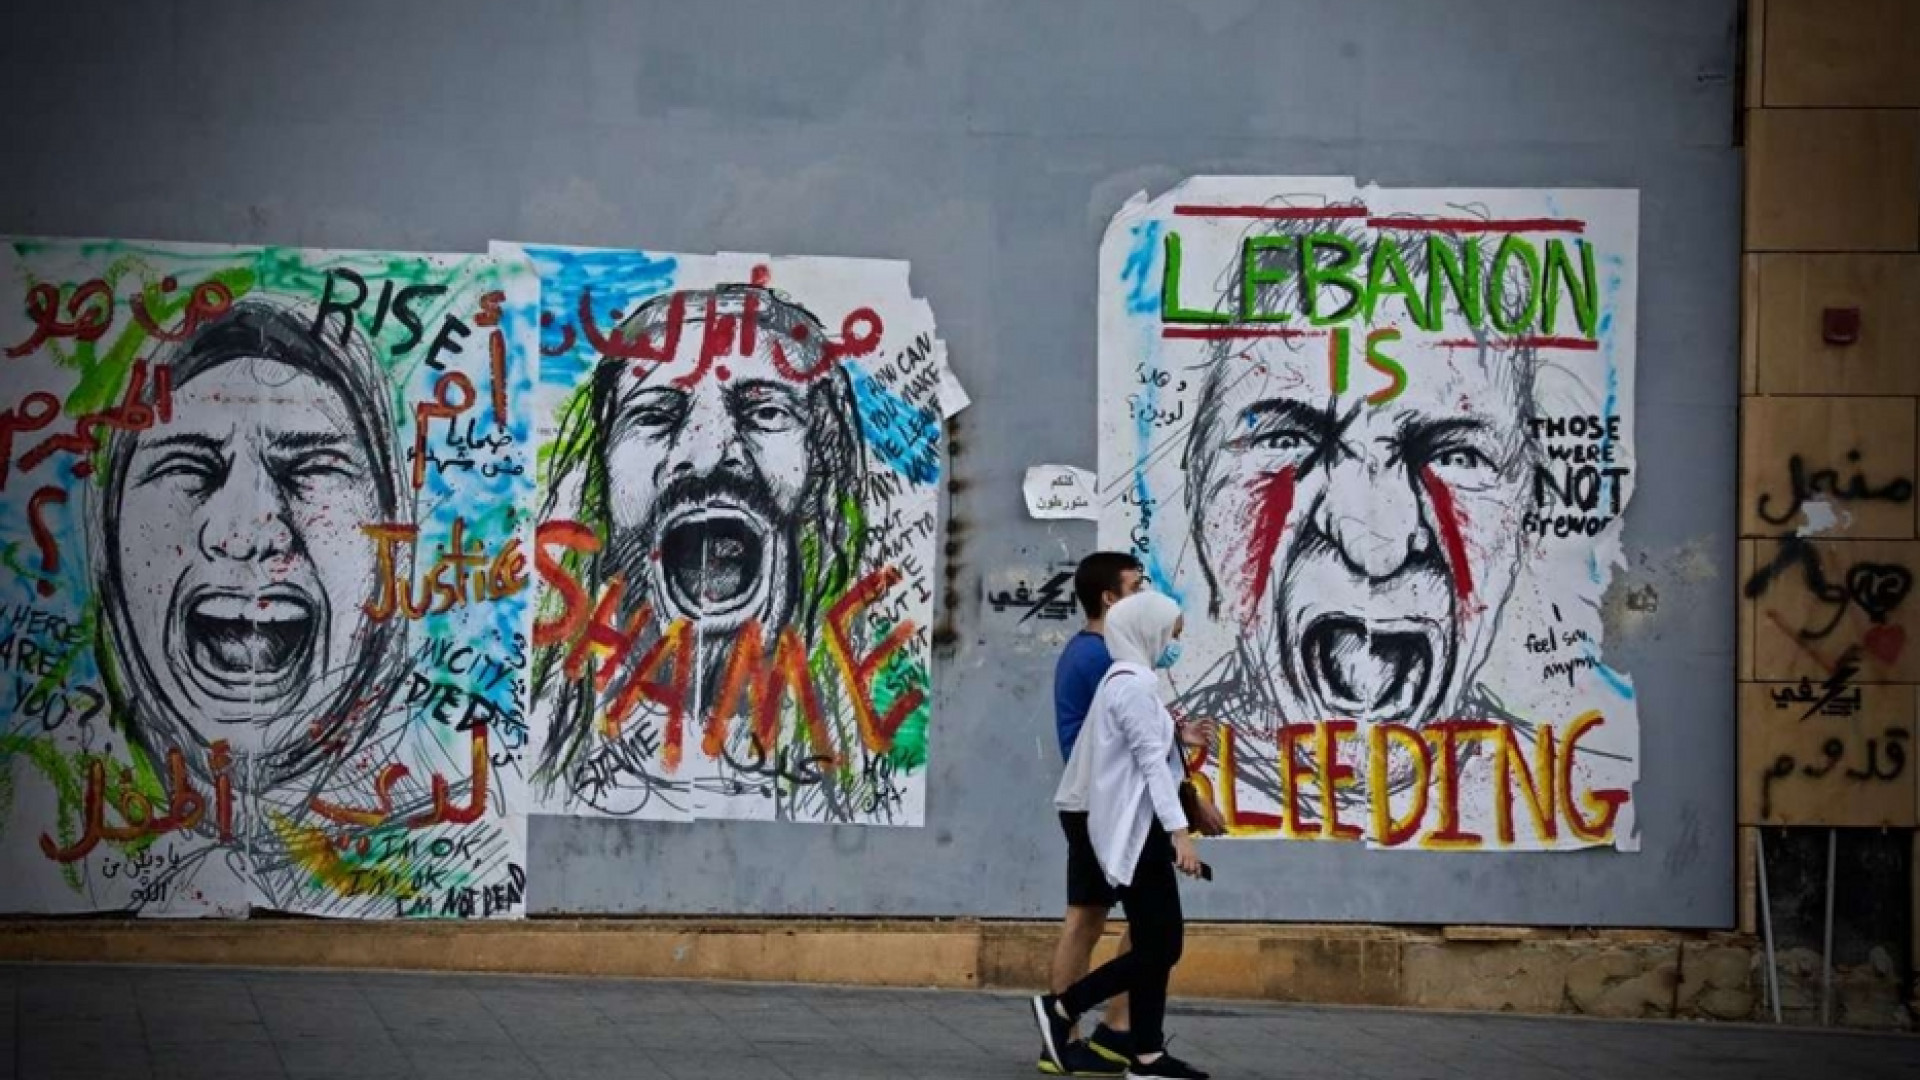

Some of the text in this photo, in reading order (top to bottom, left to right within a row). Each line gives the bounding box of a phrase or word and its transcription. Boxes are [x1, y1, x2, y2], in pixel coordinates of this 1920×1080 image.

[5, 276, 234, 359] من هو
[1160, 230, 1599, 341] LEBANON
[309, 267, 472, 371] RISE
[771, 308, 882, 382] من
[897, 331, 931, 375] CAN
[1328, 327, 1408, 405] IS
[1526, 414, 1621, 441] THOSE
[1546, 443, 1615, 464] WERE
[1533, 461, 1631, 516] NOT
[0, 603, 84, 644] HERE
[532, 518, 924, 773] SHAME
[448, 644, 514, 692] CITY
